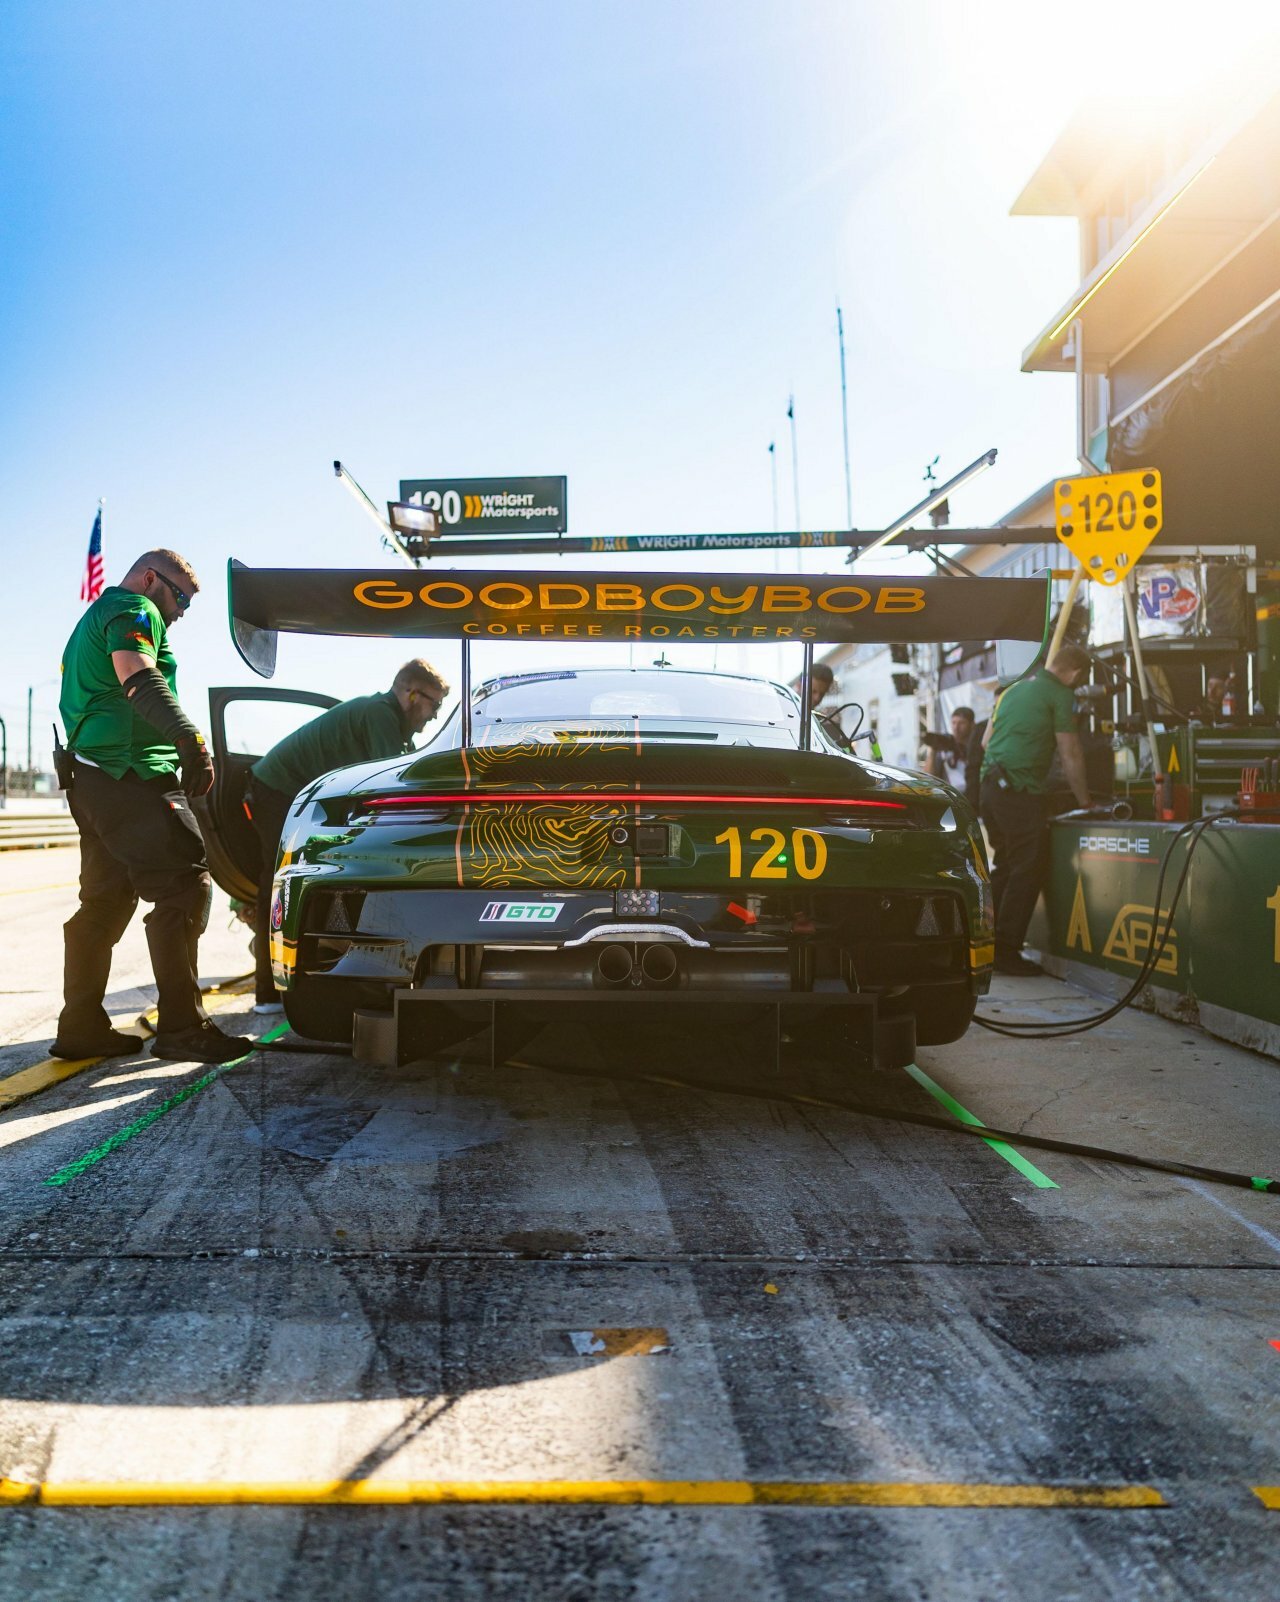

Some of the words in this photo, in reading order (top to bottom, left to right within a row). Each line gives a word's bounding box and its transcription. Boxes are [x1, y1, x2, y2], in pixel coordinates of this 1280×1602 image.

[480, 506, 559, 520] Motorsports
[1078, 490, 1137, 533] 120
[702, 535, 791, 549] Motorsports
[463, 623, 603, 637] COFFEE
[625, 624, 818, 639] ROASTERS
[1079, 836, 1150, 854] PORSCHE
[714, 827, 828, 880] 120
[505, 905, 557, 919] GTD
